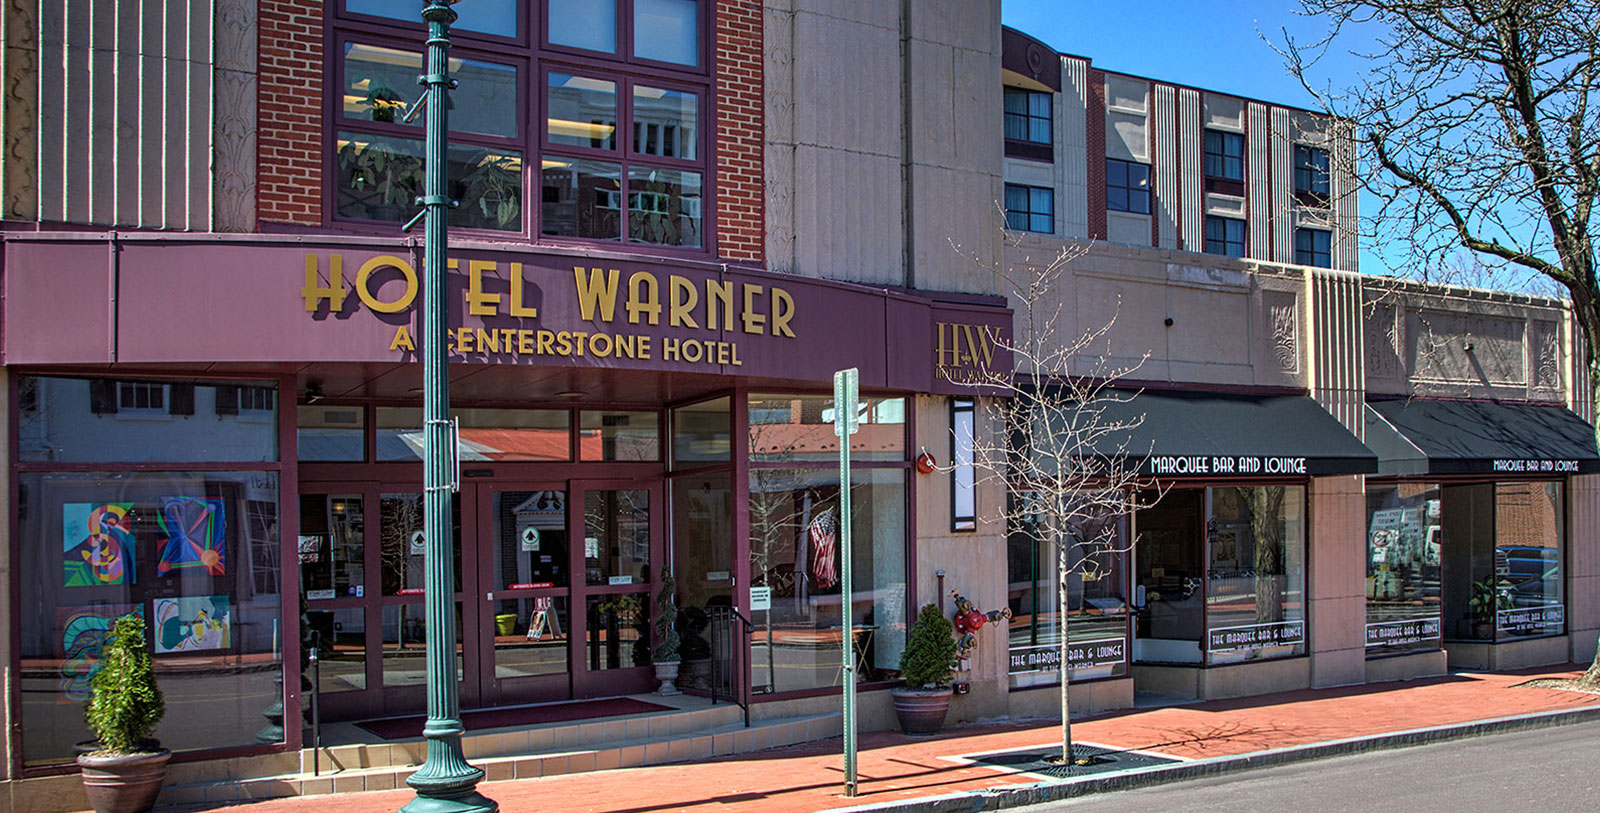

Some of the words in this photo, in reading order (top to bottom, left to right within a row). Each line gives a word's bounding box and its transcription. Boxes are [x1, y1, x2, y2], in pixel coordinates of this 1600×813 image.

[301, 253, 537, 318] HOEL
[574, 266, 796, 338] WARNER
[389, 325, 415, 351] A
[663, 338, 742, 366] HOTEL
[1151, 456, 1209, 473] MARQUEE
[1213, 457, 1235, 473] BAR
[1238, 457, 1261, 473] AND
[1265, 457, 1307, 473] LOUNGE
[1493, 460, 1525, 471] MARQUEE
[1526, 460, 1539, 471] BAR
[1540, 460, 1554, 471] AND
[1554, 460, 1579, 472] LOUNGE
[1212, 633, 1224, 646] THE
[1226, 631, 1256, 645] MARQUEE
[1258, 629, 1271, 641] BAR
[1273, 628, 1279, 640] &
[1280, 626, 1302, 639] LOUNGE
[1368, 628, 1378, 639] THE
[1404, 625, 1415, 637] BAR
[1011, 654, 1026, 667] THE
[1028, 650, 1062, 665] MARQUE
[1068, 648, 1085, 661] BAR
[1087, 647, 1094, 659] &
[1096, 645, 1123, 659] LOUNGE
